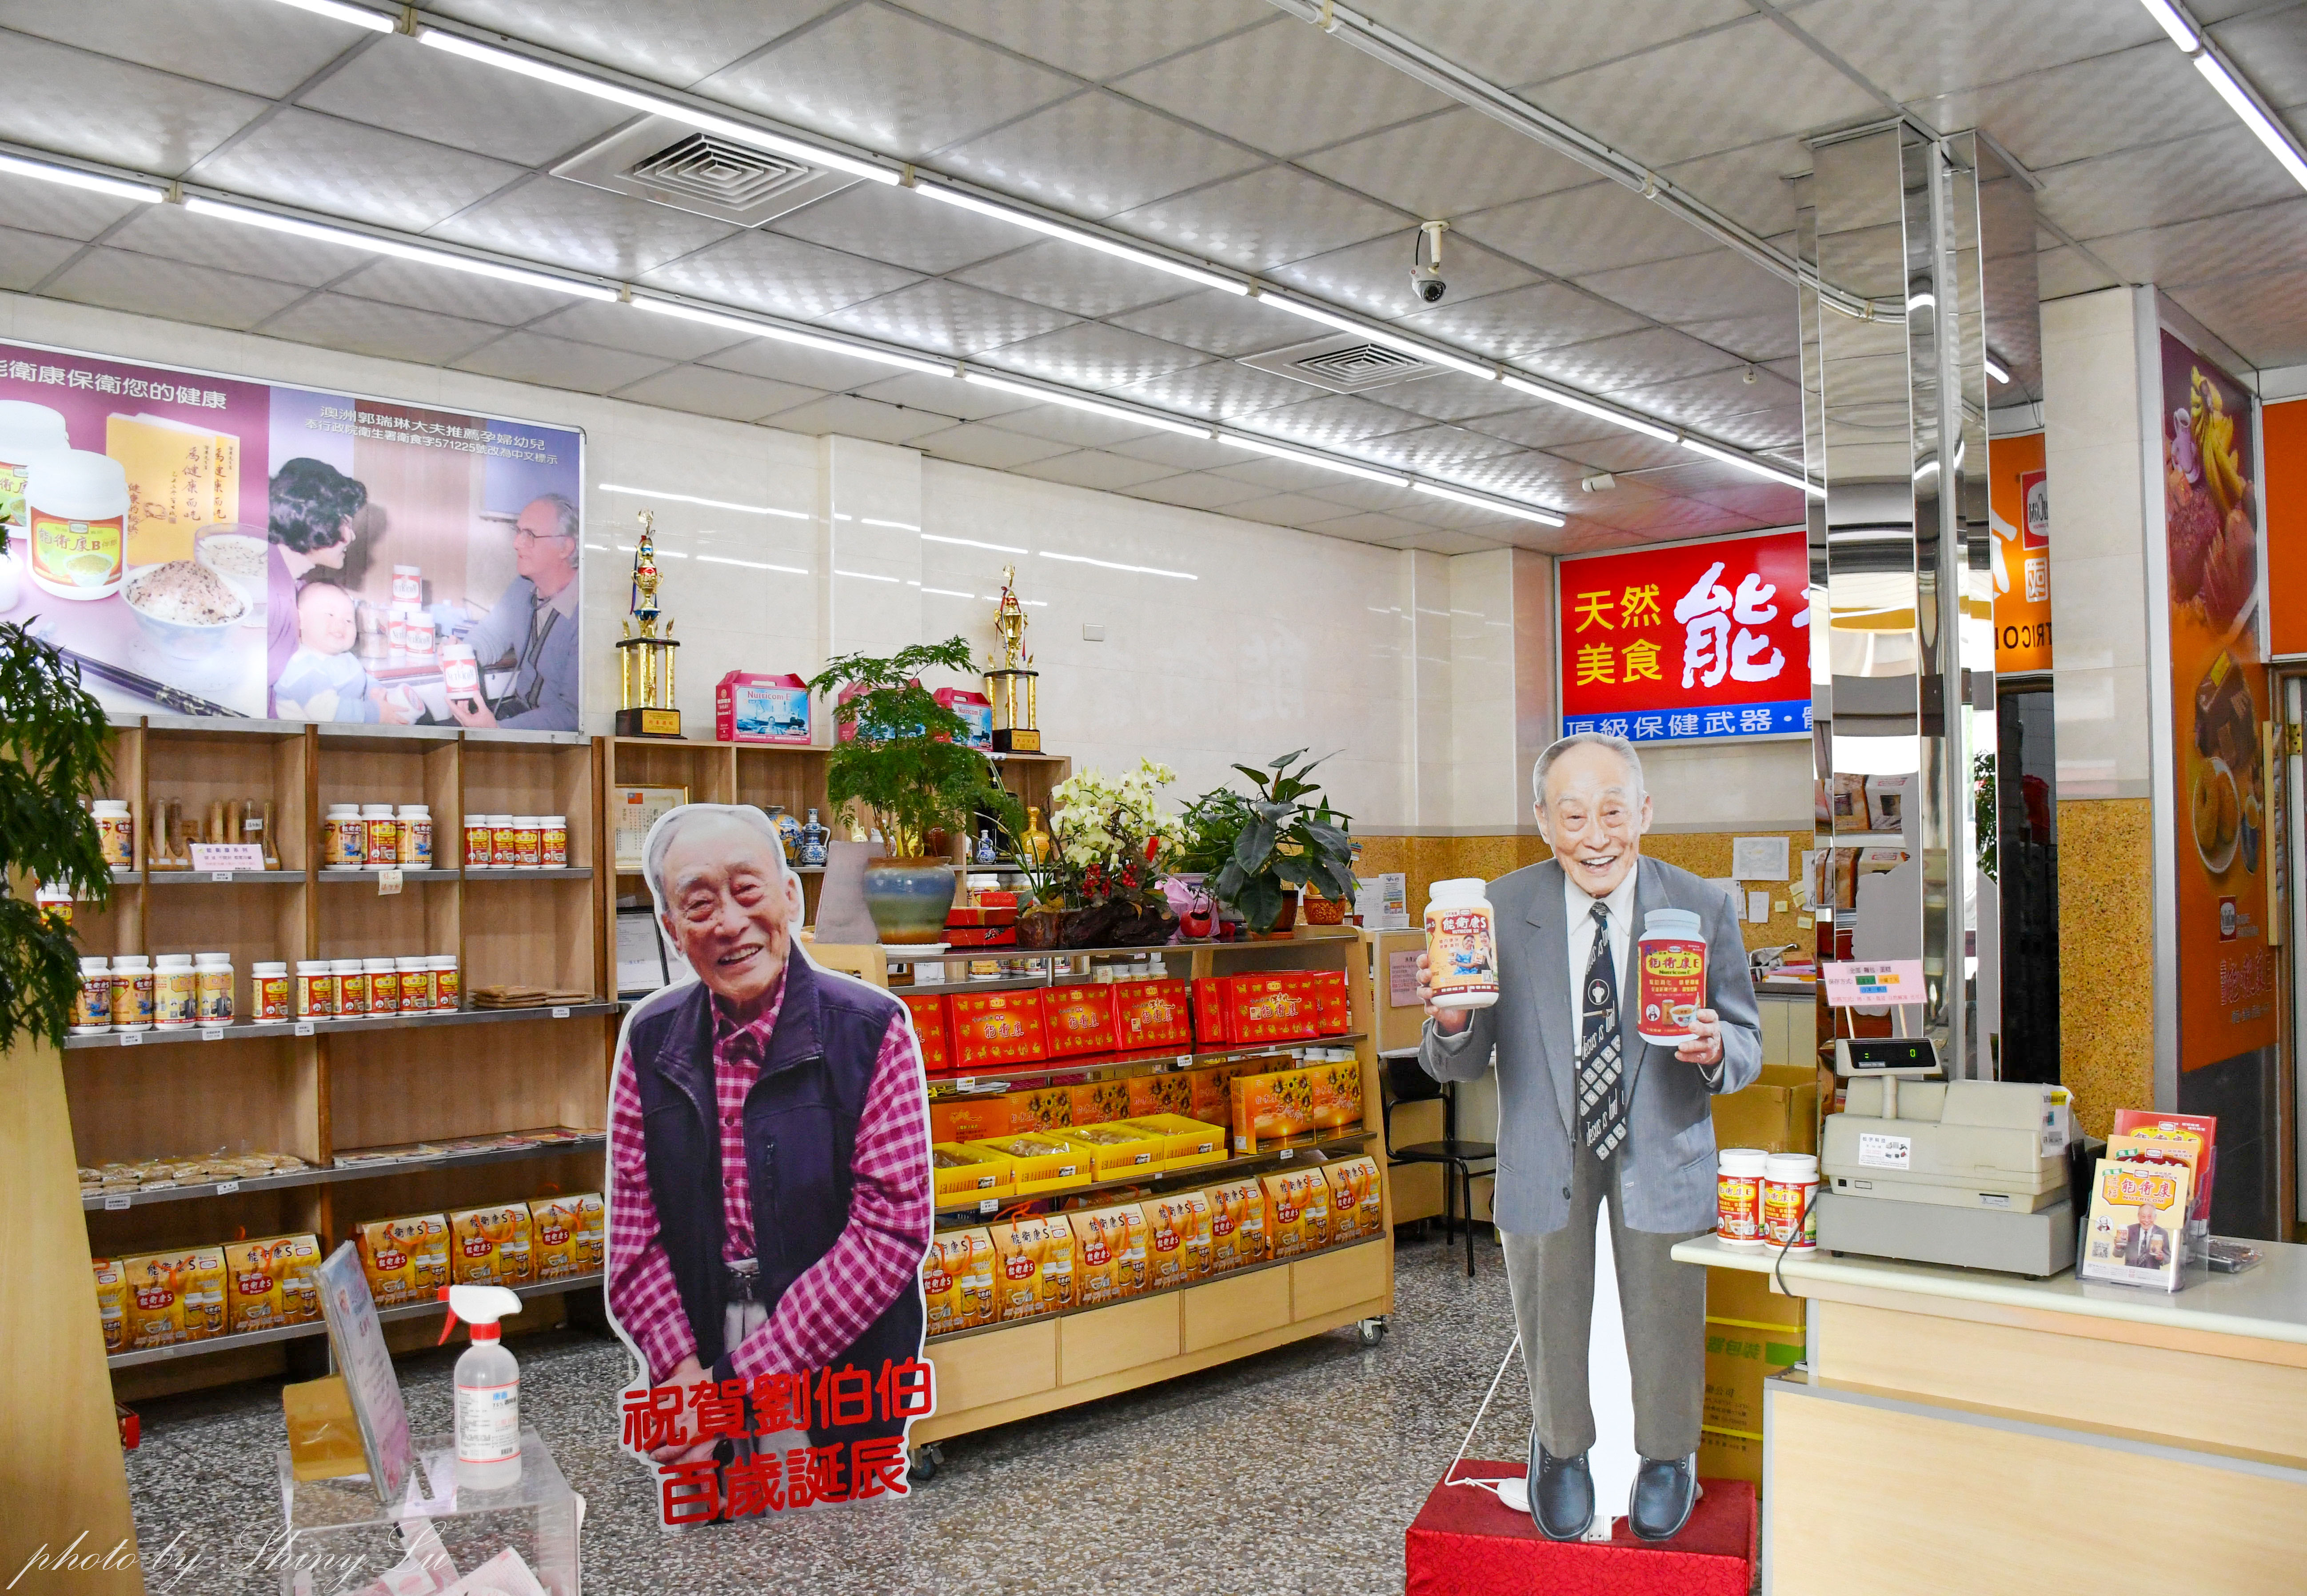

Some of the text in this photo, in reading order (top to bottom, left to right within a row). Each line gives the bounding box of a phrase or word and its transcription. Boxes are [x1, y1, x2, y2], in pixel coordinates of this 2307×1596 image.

[0, 360, 226, 409] 衛康保衛您的健康
[1574, 583, 1661, 634] 天然
[1674, 561, 1811, 689] 能
[1576, 638, 1663, 686] 美食
[747, 690, 784, 700] Nutricom
[984, 1021, 1025, 1039] 能衛康
[1068, 1012, 1099, 1029] 能衛康
[2121, 1178, 2171, 1198] 能衛康
[1011, 1228, 1050, 1245] 能衛康S
[623, 1356, 933, 1453] 祝賀劉伯伯
[658, 1435, 909, 1525] 百歲誕辰
